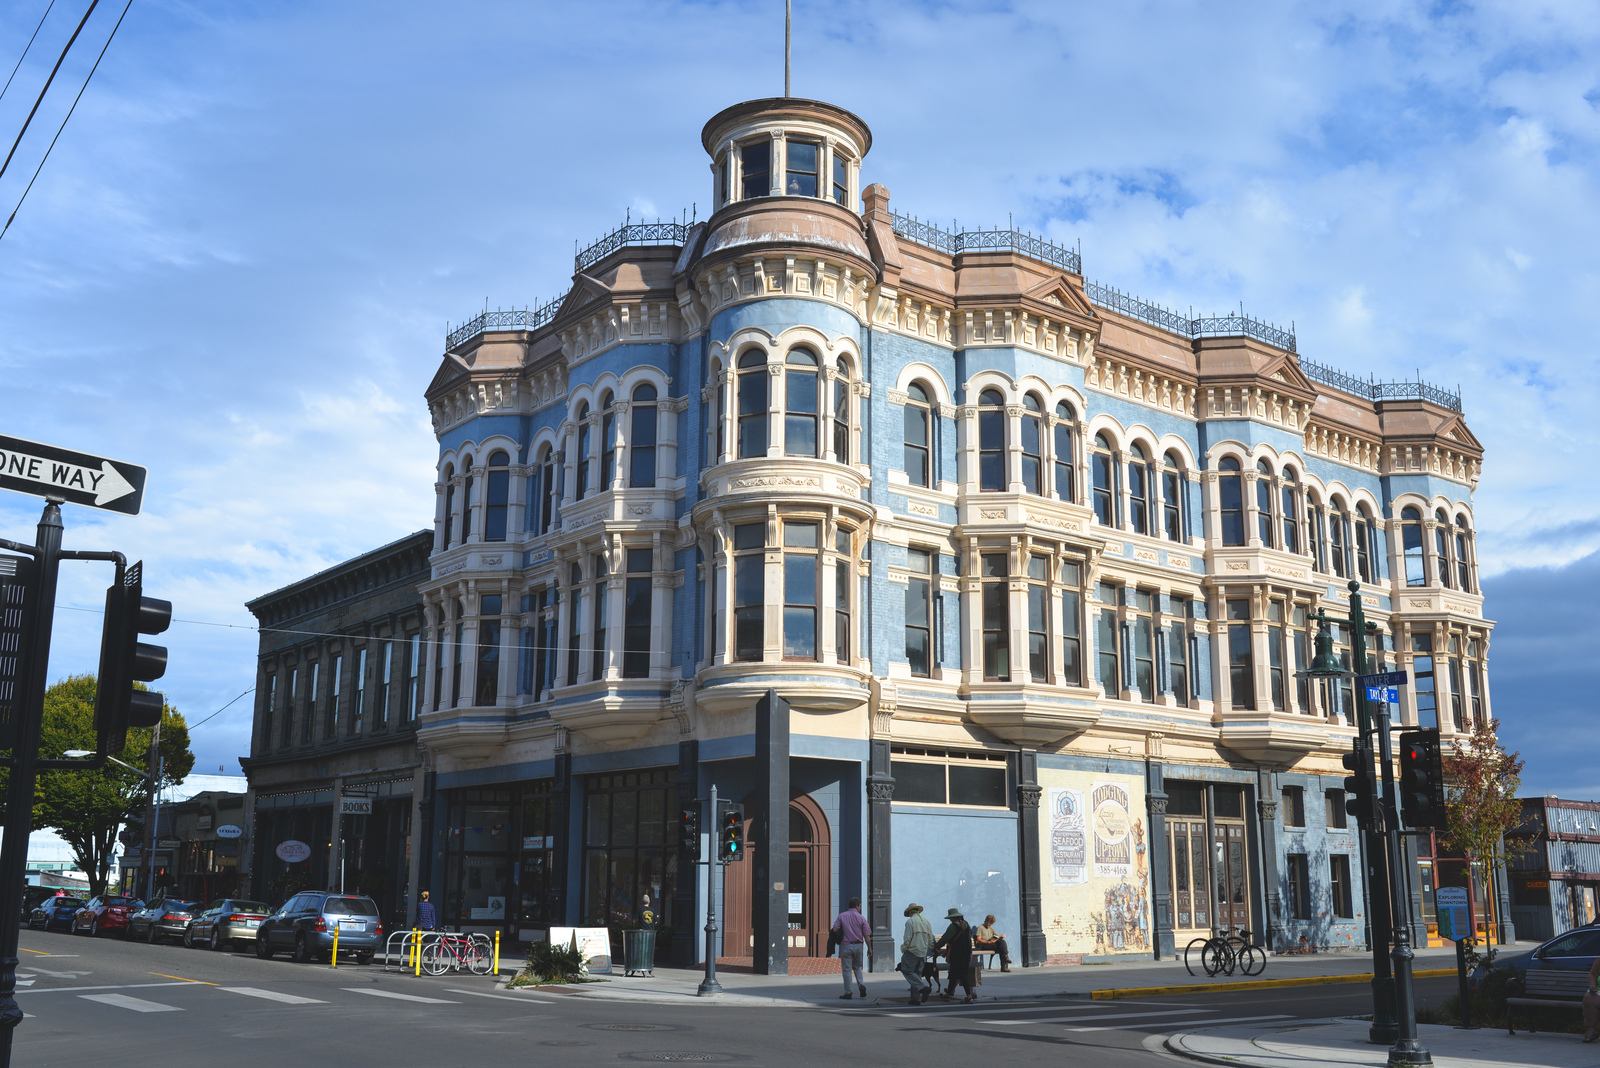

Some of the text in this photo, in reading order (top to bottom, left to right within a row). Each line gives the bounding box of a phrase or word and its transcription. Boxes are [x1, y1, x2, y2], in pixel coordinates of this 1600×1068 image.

[52, 463, 104, 491] WAY
[1363, 675, 1390, 687] WATER
[1094, 785, 1128, 808] LODGING
[343, 802, 369, 813] BOOKS
[1053, 837, 1084, 846] SEAFOOD
[1096, 834, 1128, 857] UPTOWN
[1053, 850, 1083, 858] RESTAURANT
